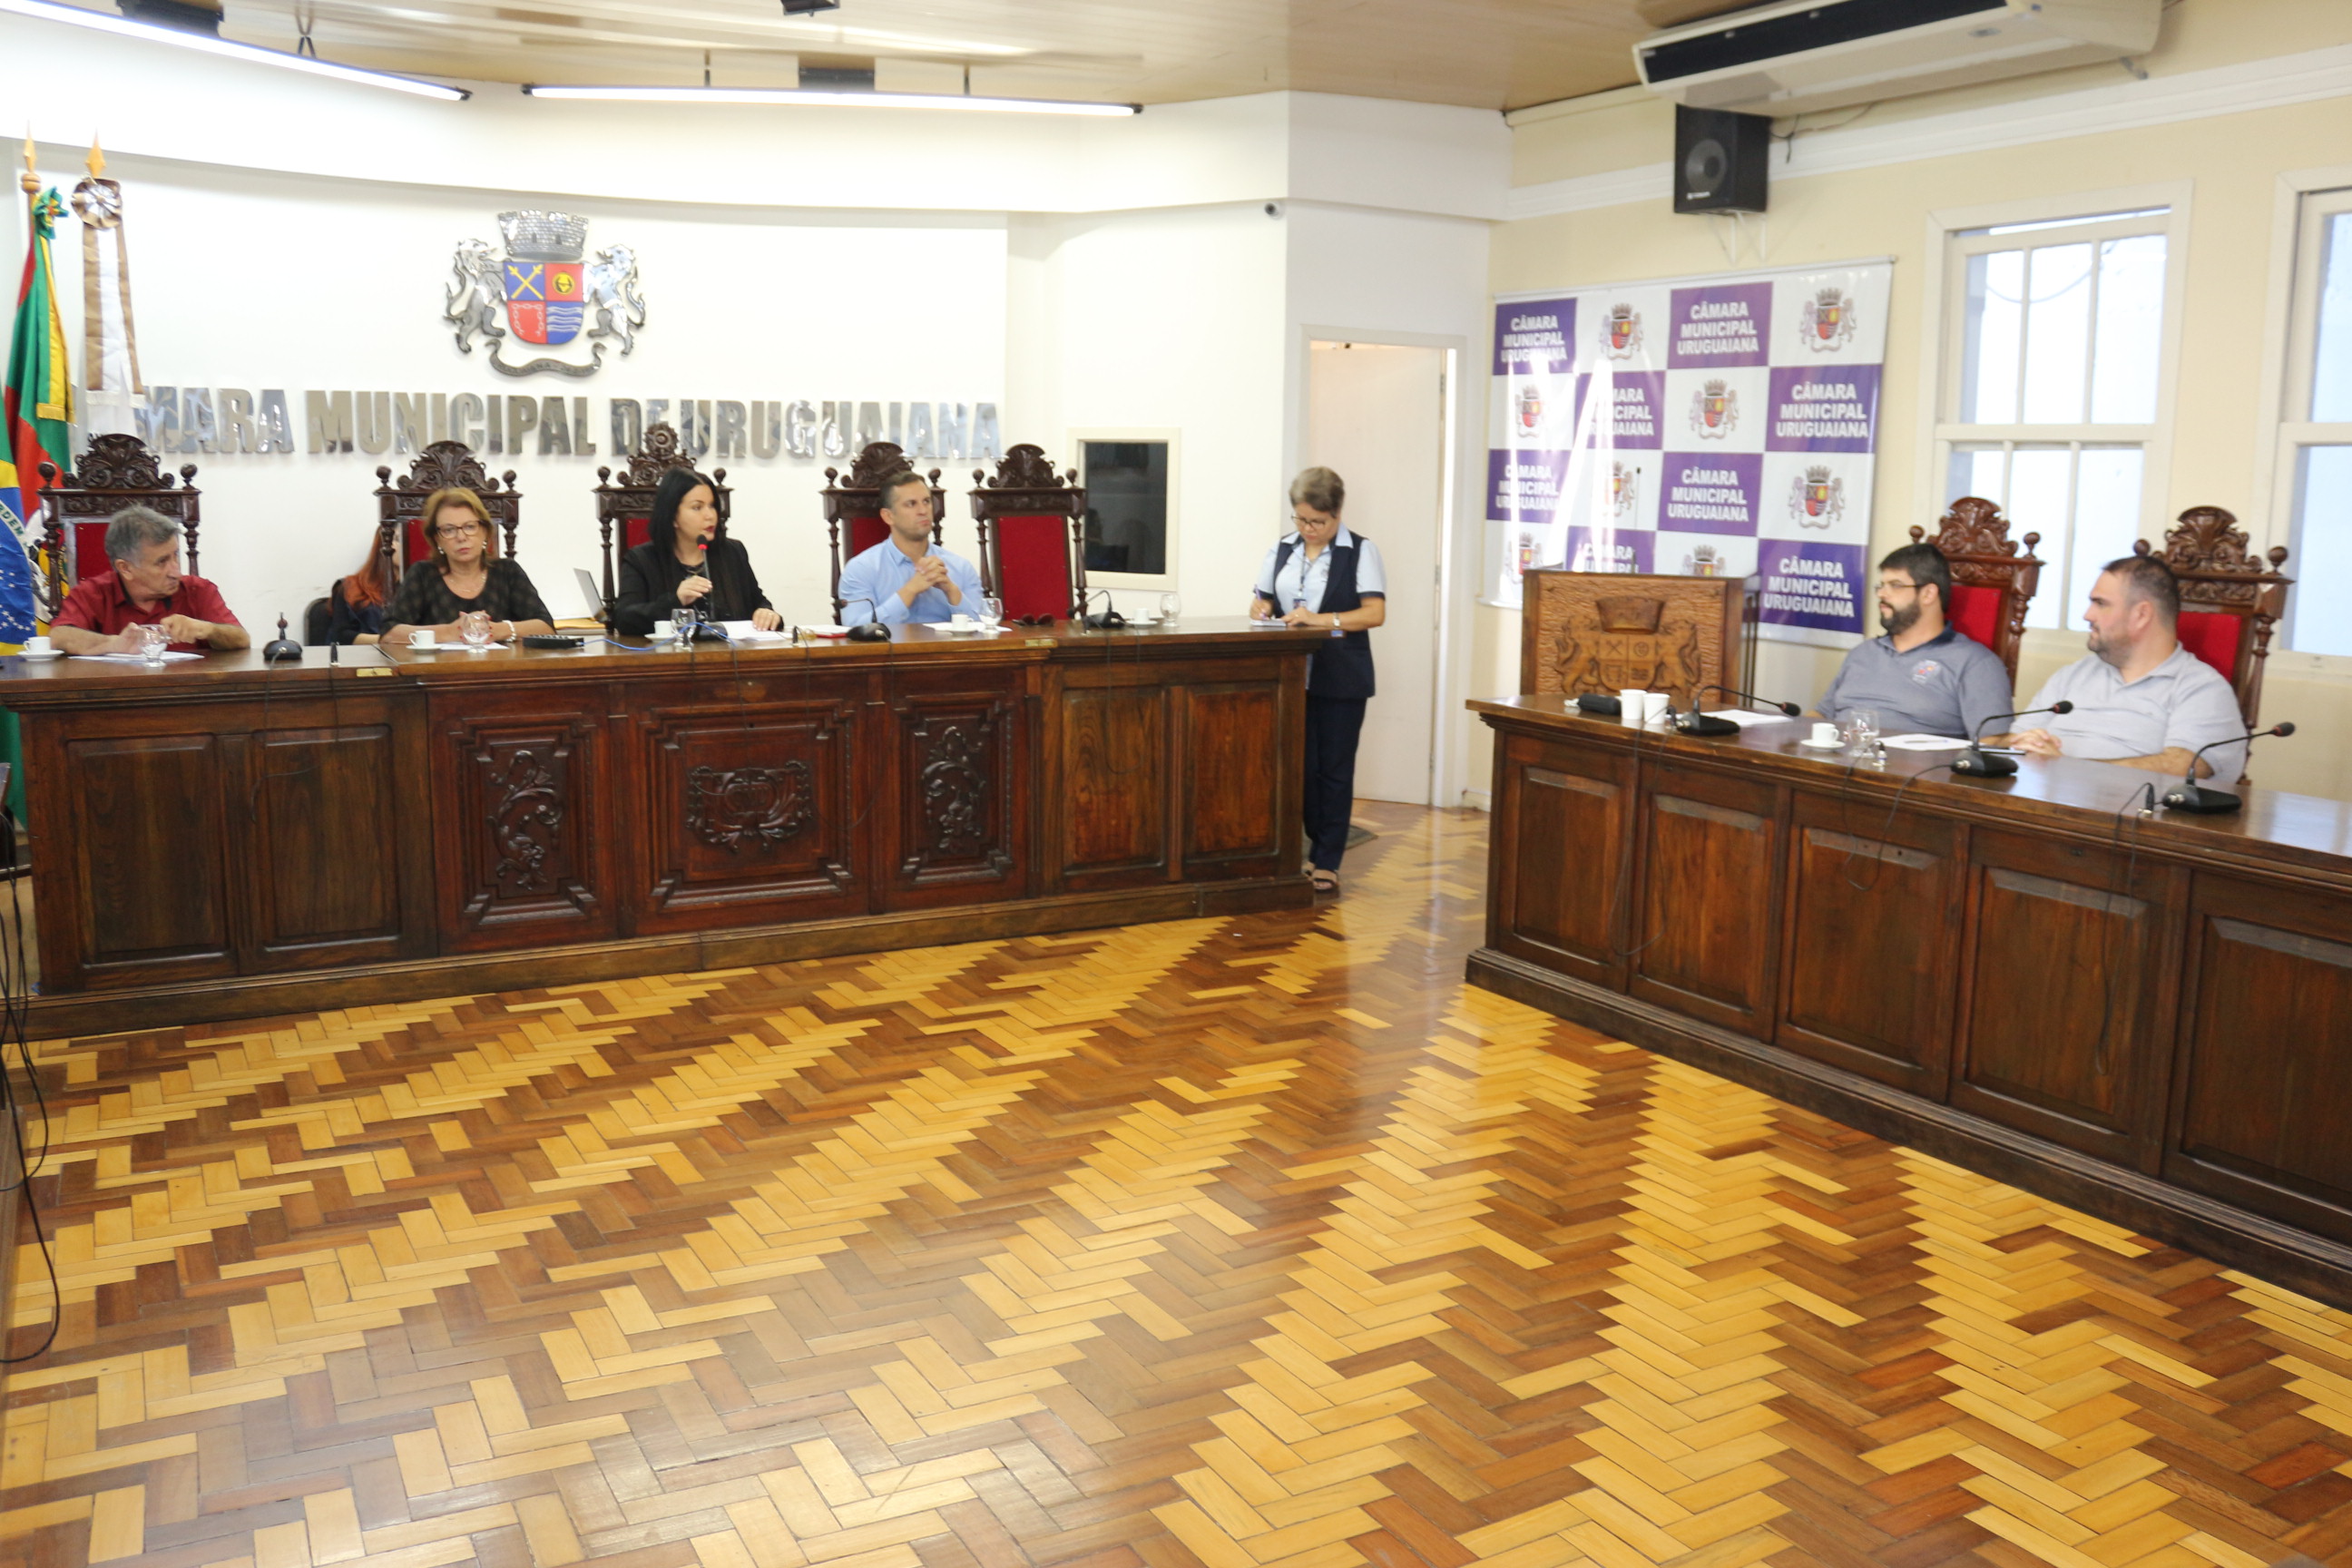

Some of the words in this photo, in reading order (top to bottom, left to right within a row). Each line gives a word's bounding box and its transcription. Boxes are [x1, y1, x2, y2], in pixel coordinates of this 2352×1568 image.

[1690, 301, 1749, 319] CÂMARA
[1511, 315, 1558, 331] CÂMARA
[1681, 319, 1757, 338] MUNICIPAL
[1504, 331, 1565, 347] MUNICIPAL
[1678, 337, 1759, 355] URUGUAIANA
[1792, 381, 1857, 400] CÂMARA
[1780, 403, 1867, 419] MUNICIPAL
[132, 386, 295, 454] MARA
[306, 390, 595, 456] MUNICIPAL
[681, 399, 1004, 459] URUGUAIANA
[1776, 421, 1869, 437] URUGUAIANA
[1504, 465, 1553, 478] CMARA
[1681, 466, 1739, 485] CÂMARA
[1671, 486, 1748, 505] MUNICIPAL
[1668, 504, 1749, 522] URUGUAIANA
[1779, 555, 1844, 579] CÂMARA
[1768, 575, 1853, 599] MUNICIPAL
[1763, 593, 1855, 618] URUGUAIANA
